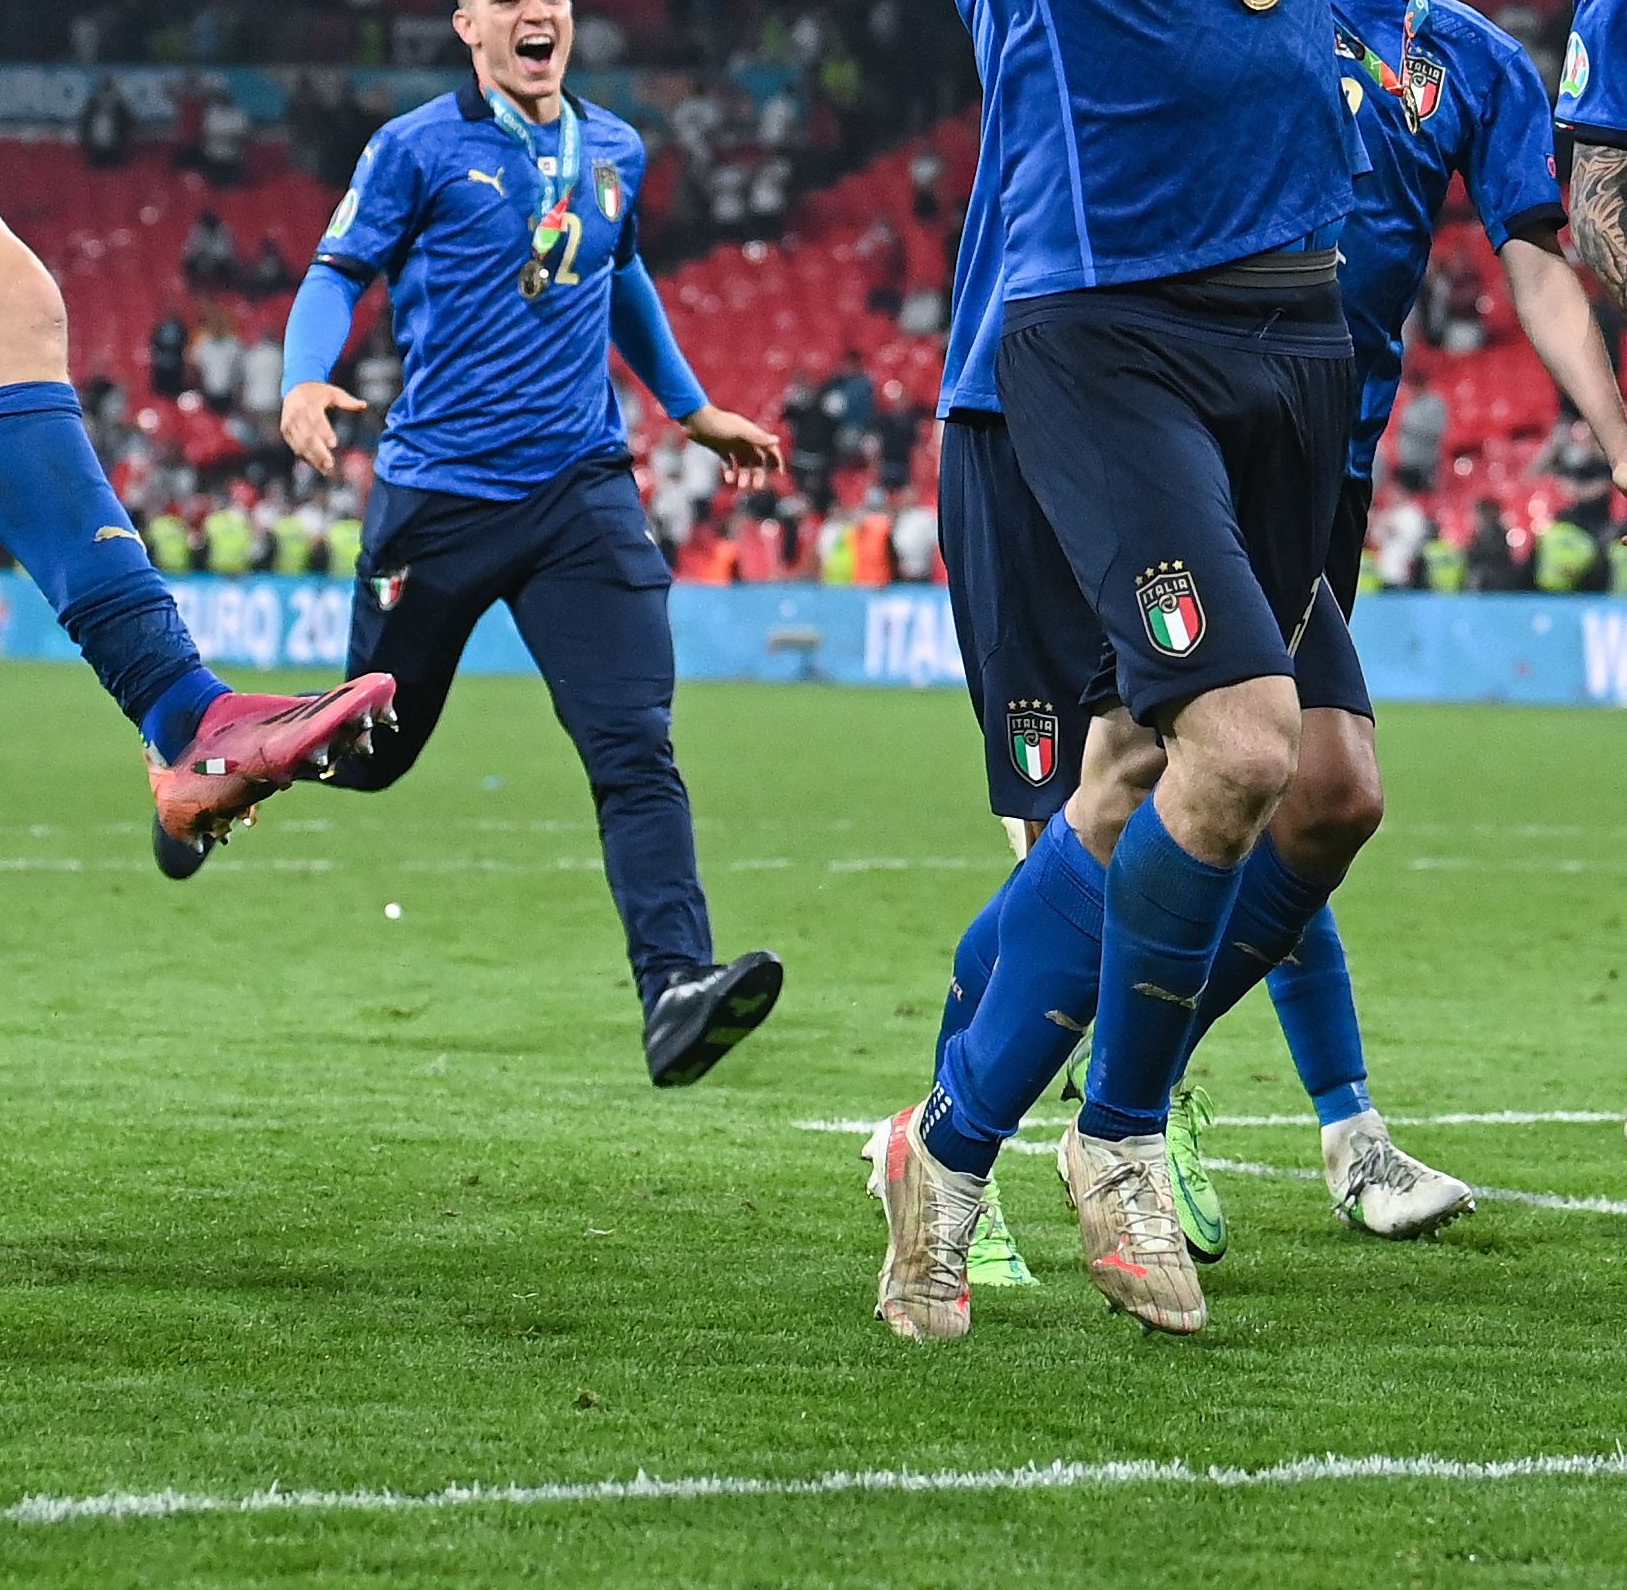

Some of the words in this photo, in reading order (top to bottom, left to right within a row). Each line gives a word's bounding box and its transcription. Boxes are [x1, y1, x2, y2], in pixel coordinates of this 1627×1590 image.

[1407, 60, 1441, 79] TALIA
[1142, 579, 1189, 604] ITALIA
[171, 582, 279, 664] URO
[1011, 718, 1053, 732] ITALIA
